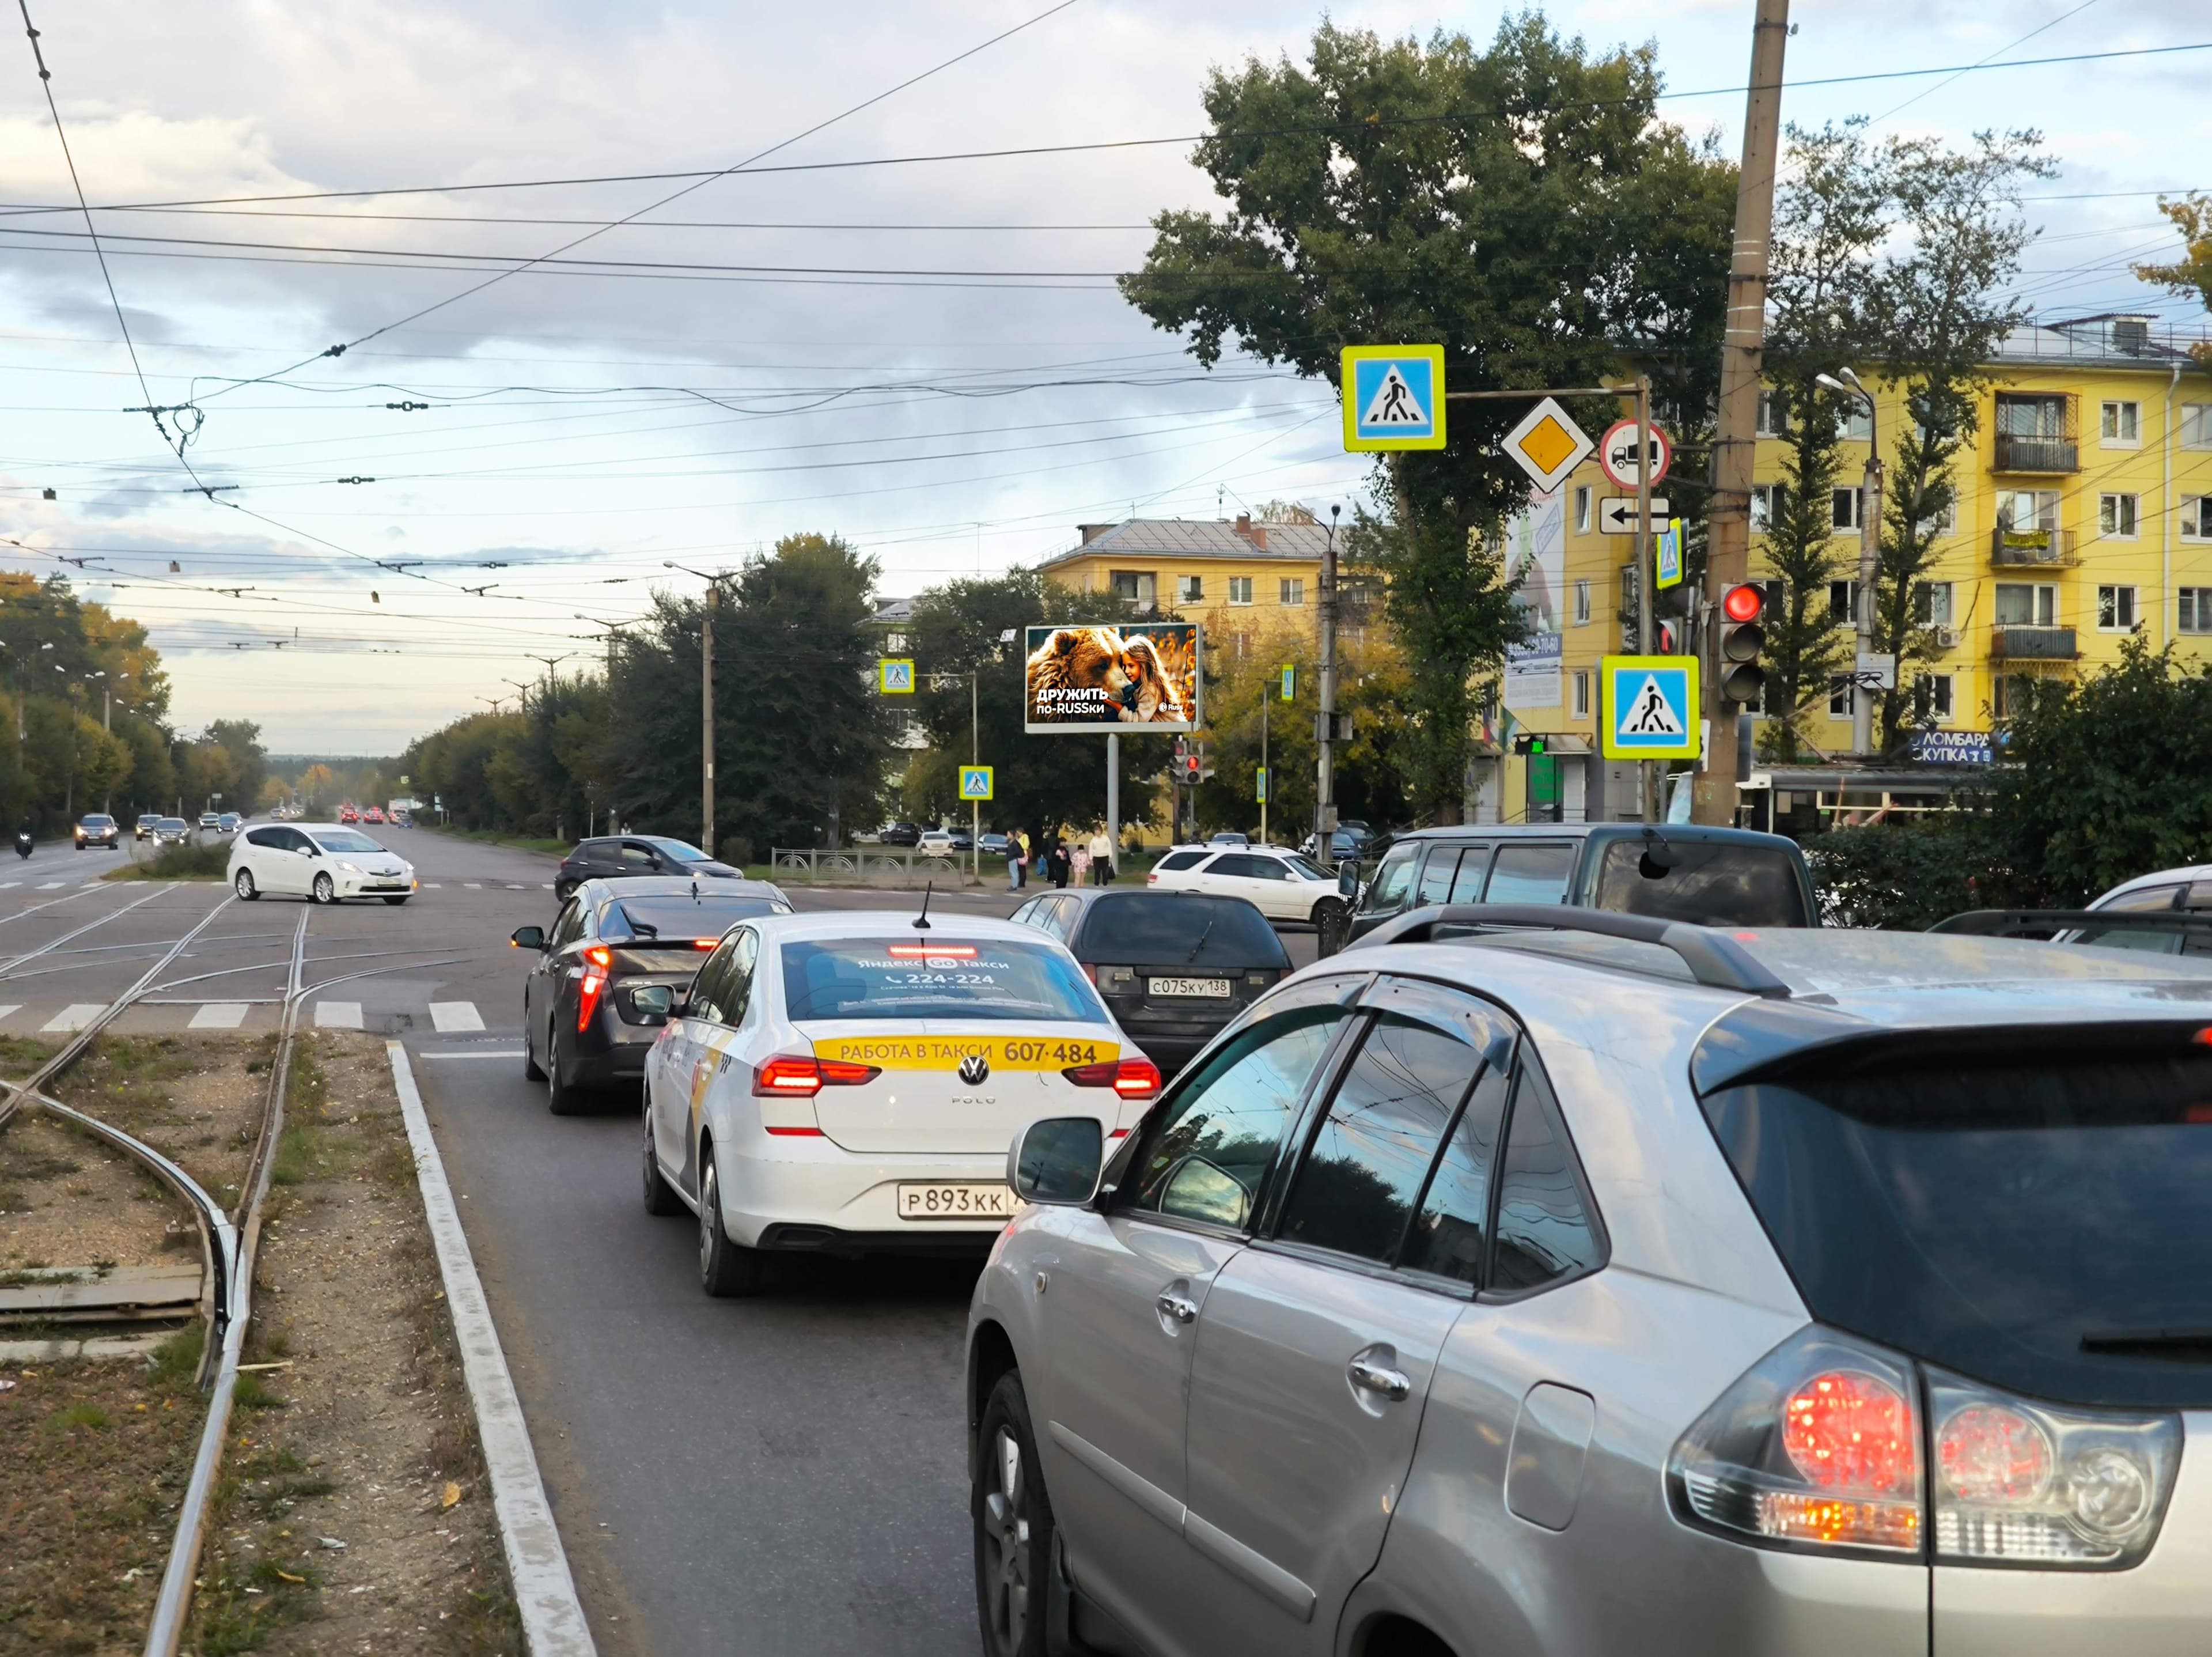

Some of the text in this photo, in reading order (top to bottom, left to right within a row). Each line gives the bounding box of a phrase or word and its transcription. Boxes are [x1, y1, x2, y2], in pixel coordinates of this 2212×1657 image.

[1036, 688, 1109, 703] ДРУЖИТЬ
[1036, 702, 1105, 714] по-RUSSки
[858, 959, 923, 969] Яндекс
[959, 959, 1009, 969] Такси
[906, 974, 994, 984] 224-224
[1207, 980, 1226, 991] 138
[841, 1045, 911, 1059] РАБОТА
[917, 1045, 926, 1058] В
[931, 1044, 992, 1058] ТАКСИ
[952, 1096, 996, 1104] POLO
